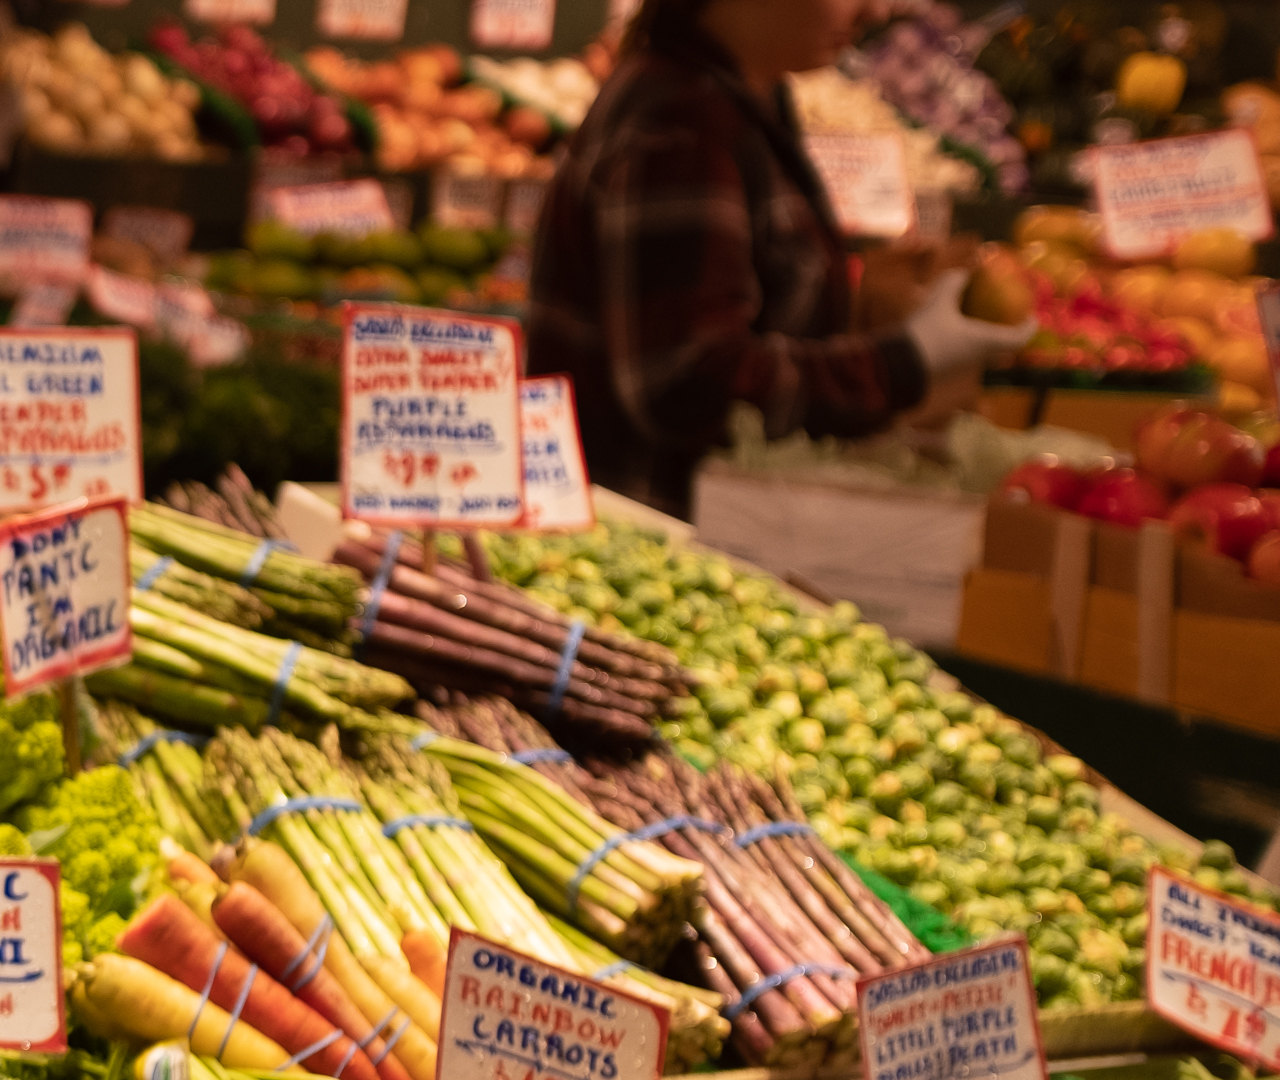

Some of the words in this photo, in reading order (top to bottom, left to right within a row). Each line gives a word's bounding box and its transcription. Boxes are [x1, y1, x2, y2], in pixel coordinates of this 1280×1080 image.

[1, 542, 100, 606] PANIC
[11, 600, 118, 673] ORGANIC
[459, 973, 627, 1050] RAINBOW
[472, 948, 618, 1020] ORGANIC
[472, 1013, 619, 1080] CARROTS
[877, 1024, 934, 1064] LITTLE
